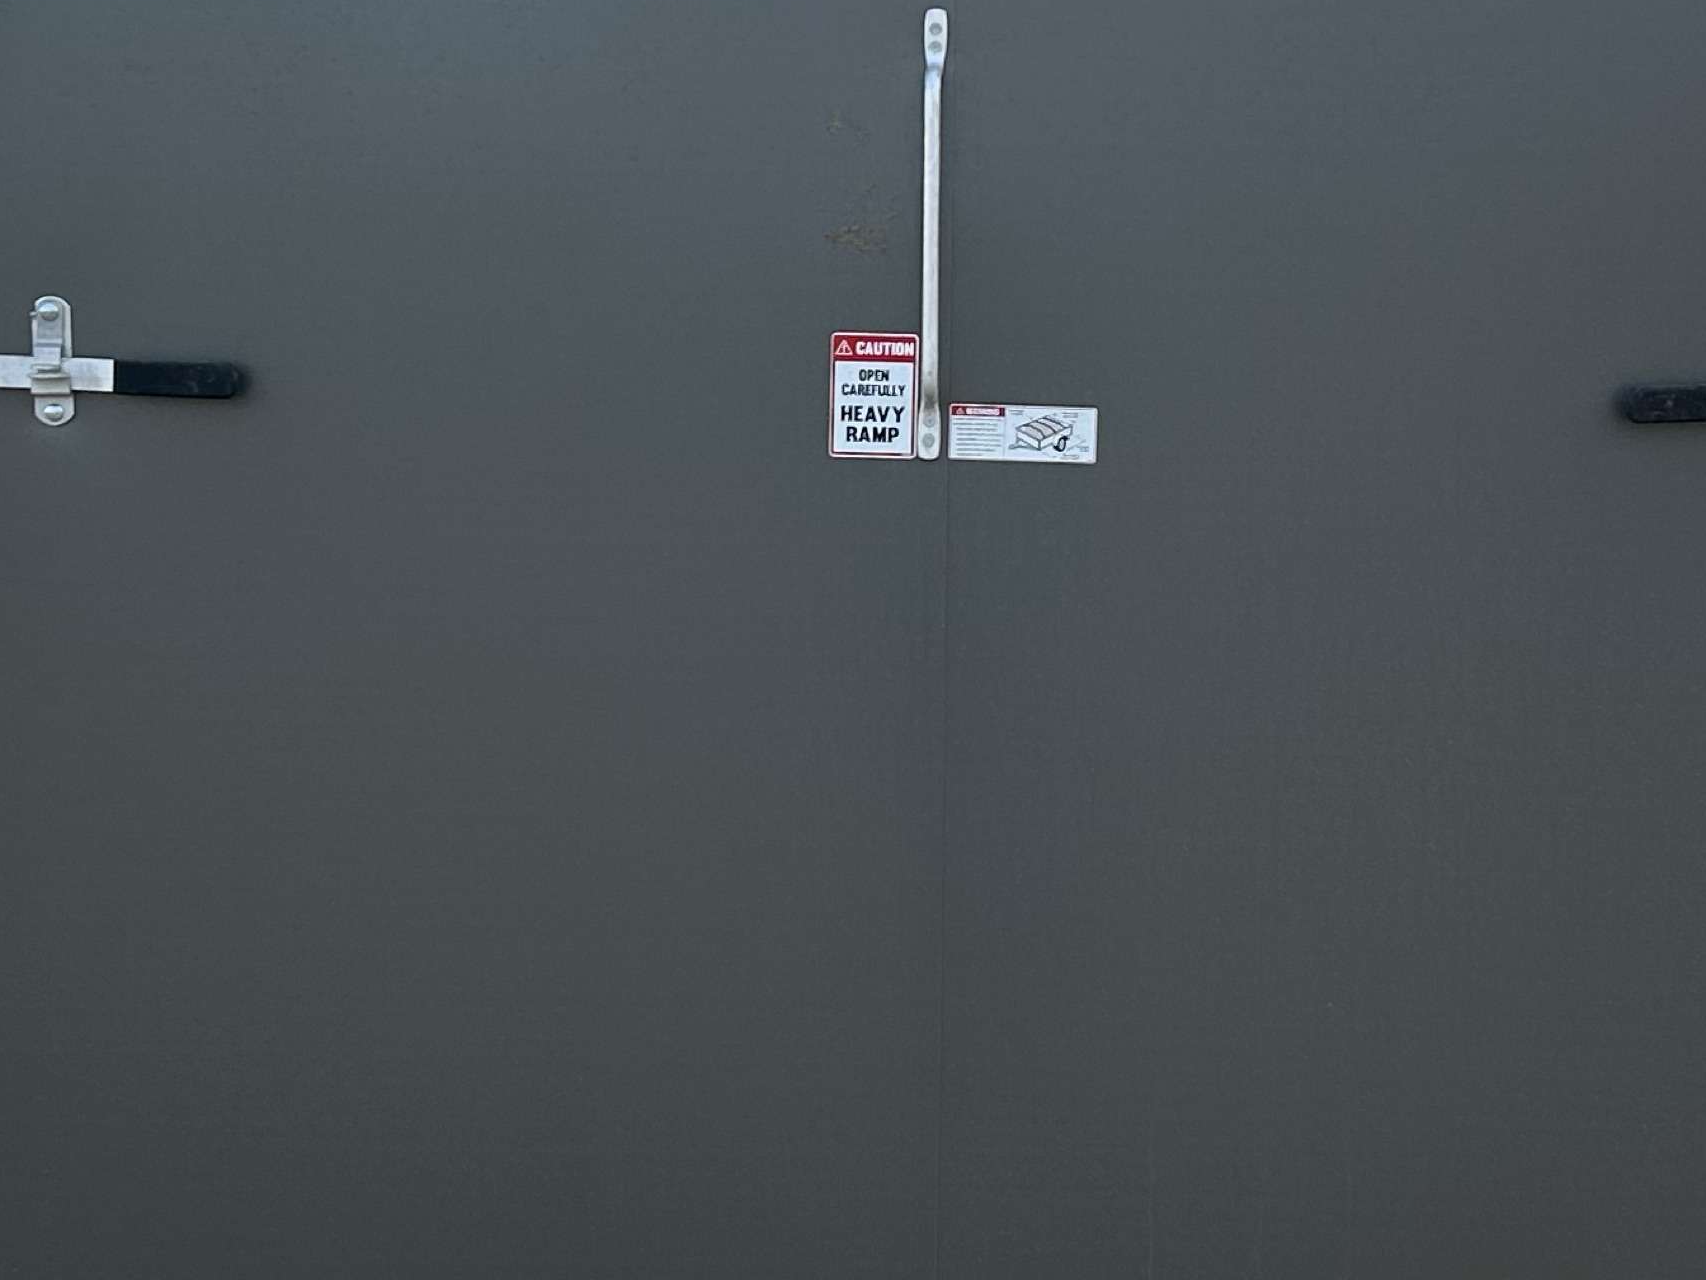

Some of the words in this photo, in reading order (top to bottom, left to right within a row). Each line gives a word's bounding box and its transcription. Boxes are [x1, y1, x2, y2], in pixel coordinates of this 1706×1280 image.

[856, 341, 915, 356] CAUTION
[859, 369, 890, 381] OPEN
[841, 384, 906, 396] CAREFULLY
[840, 405, 905, 423] HEAVY
[846, 426, 900, 443] RAMP
